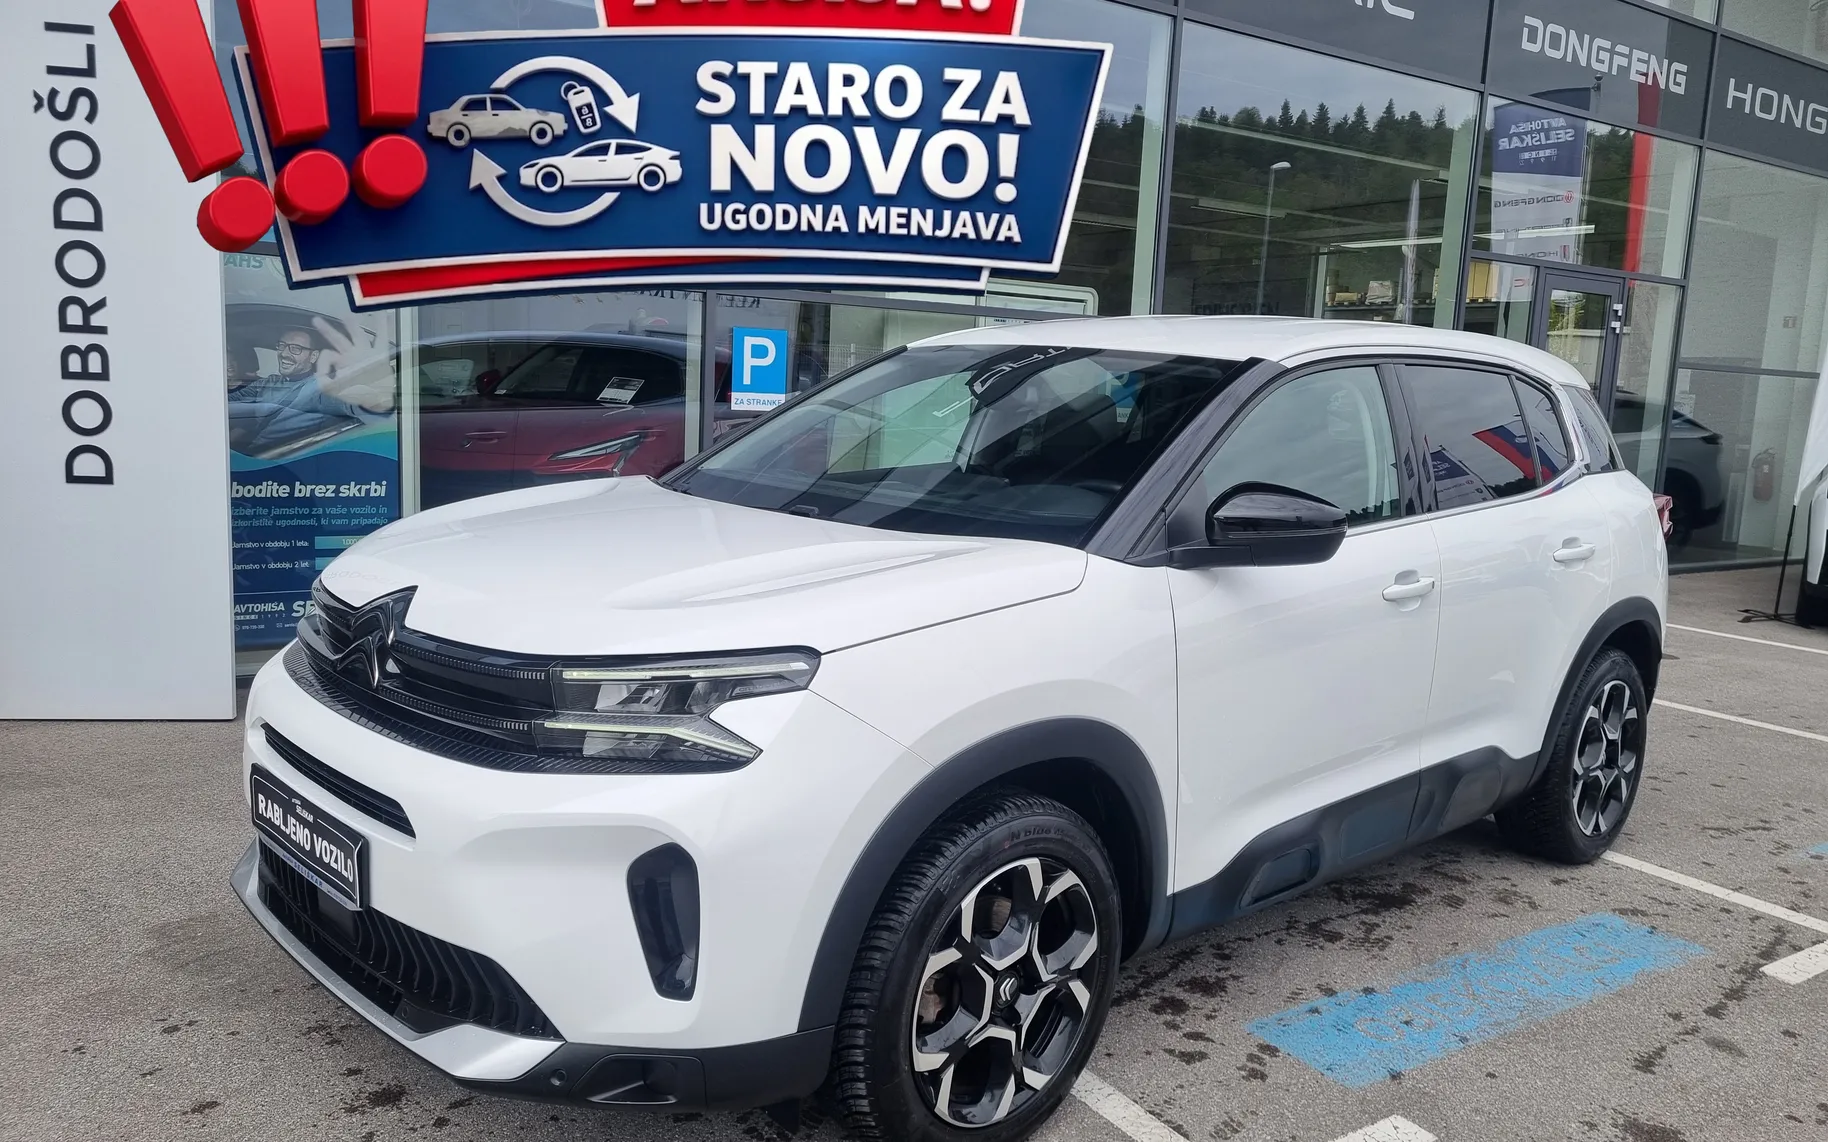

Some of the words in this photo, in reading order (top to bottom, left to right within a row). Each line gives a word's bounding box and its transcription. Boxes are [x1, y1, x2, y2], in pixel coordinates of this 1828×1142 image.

[1521, 15, 1688, 95] DONGFENG
[1726, 78, 1828, 134] HONG
[32, 21, 114, 485] DOBRODOŠLI
[743, 336, 776, 385] P
[294, 482, 335, 497] brez
[339, 481, 387, 497] skrbi
[270, 506, 310, 516] jamstvo
[325, 505, 347, 514] vaše
[350, 505, 377, 514] vozilo
[379, 505, 388, 514] in
[275, 518, 318, 527] ugodnosti,
[351, 517, 388, 526] pripadajo
[265, 541, 291, 549] obdobju
[268, 561, 293, 570] obdobju
[234, 602, 285, 613] AVTOHIŠA
[258, 793, 311, 851] RABLJENO
[313, 834, 354, 883] VOZILO
